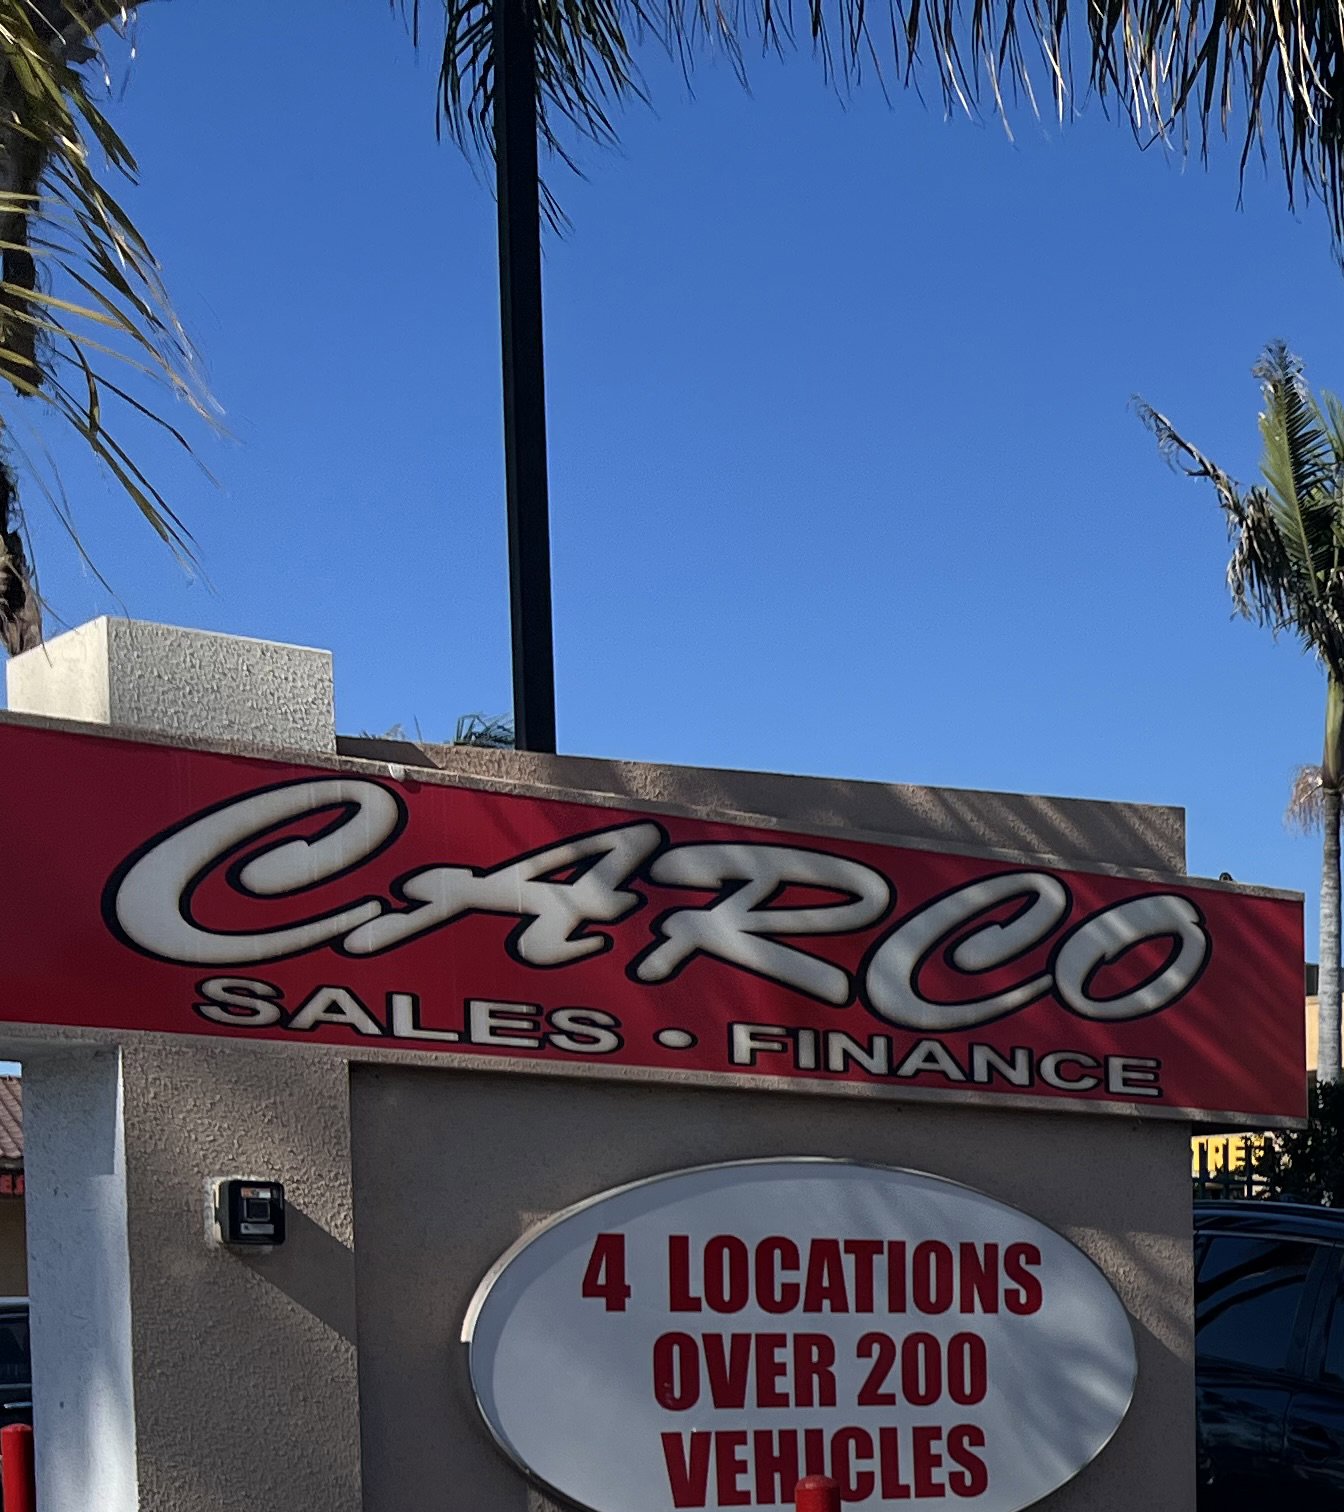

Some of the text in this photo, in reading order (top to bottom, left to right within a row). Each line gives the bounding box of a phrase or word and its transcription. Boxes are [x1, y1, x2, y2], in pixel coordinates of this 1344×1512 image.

[103, 777, 1209, 1031] CARCO
[197, 976, 1162, 1100] SALES FINANCE
[582, 1233, 1043, 1315] 4 LOCATIONS
[653, 1332, 988, 1411] OVER 200
[661, 1424, 988, 1509] VEHICLES
